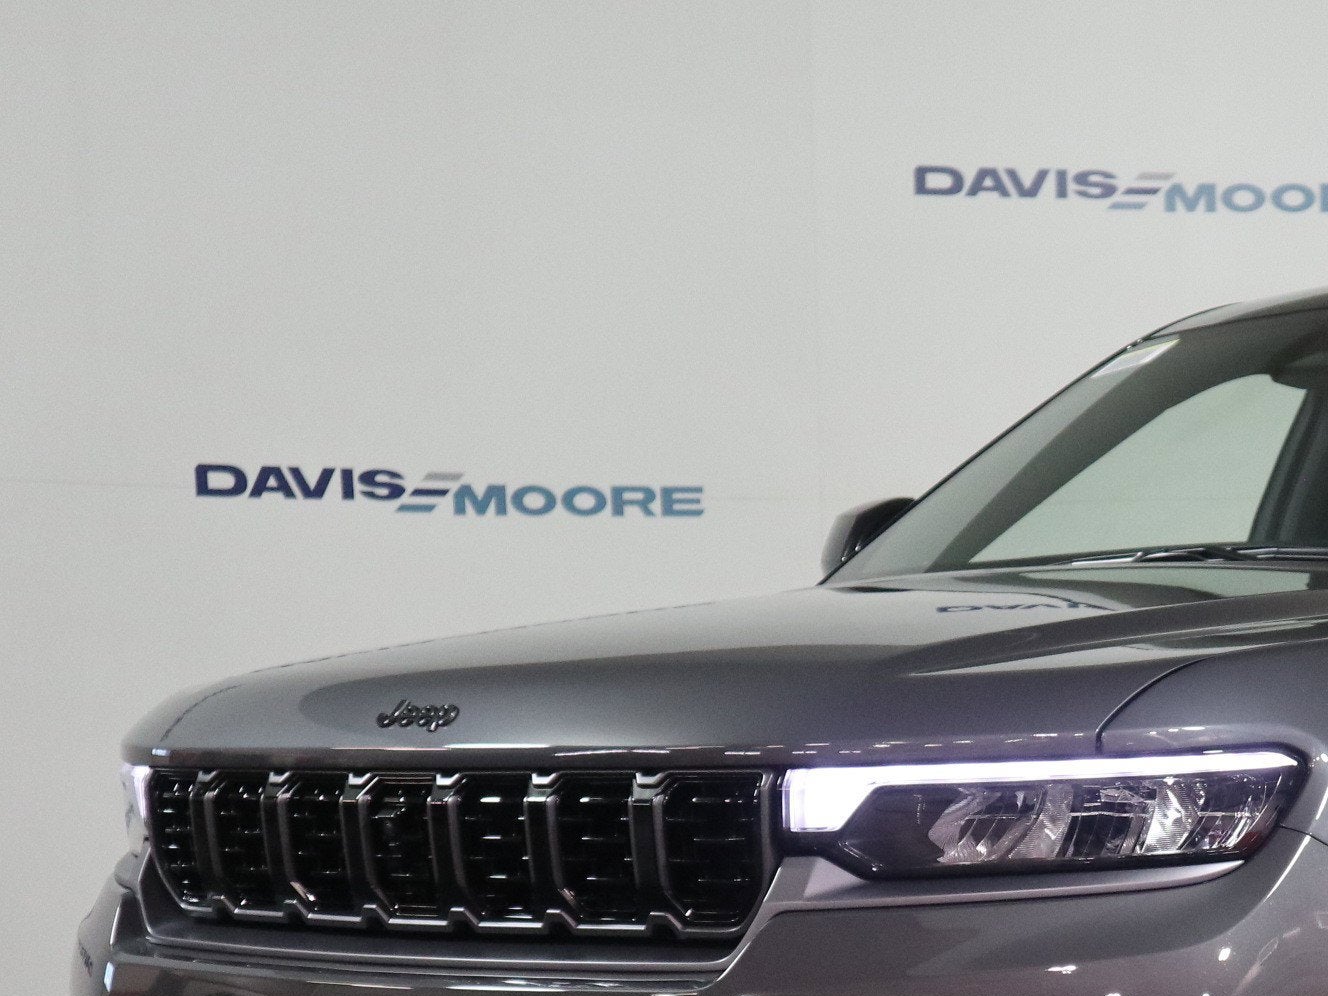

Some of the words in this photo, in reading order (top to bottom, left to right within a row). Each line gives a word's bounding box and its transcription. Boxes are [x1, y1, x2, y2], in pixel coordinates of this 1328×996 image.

[913, 165, 1118, 200] DAVIS
[194, 463, 406, 502] DAVIS
[453, 484, 705, 518] MOORE
[376, 699, 459, 733] Jeep
